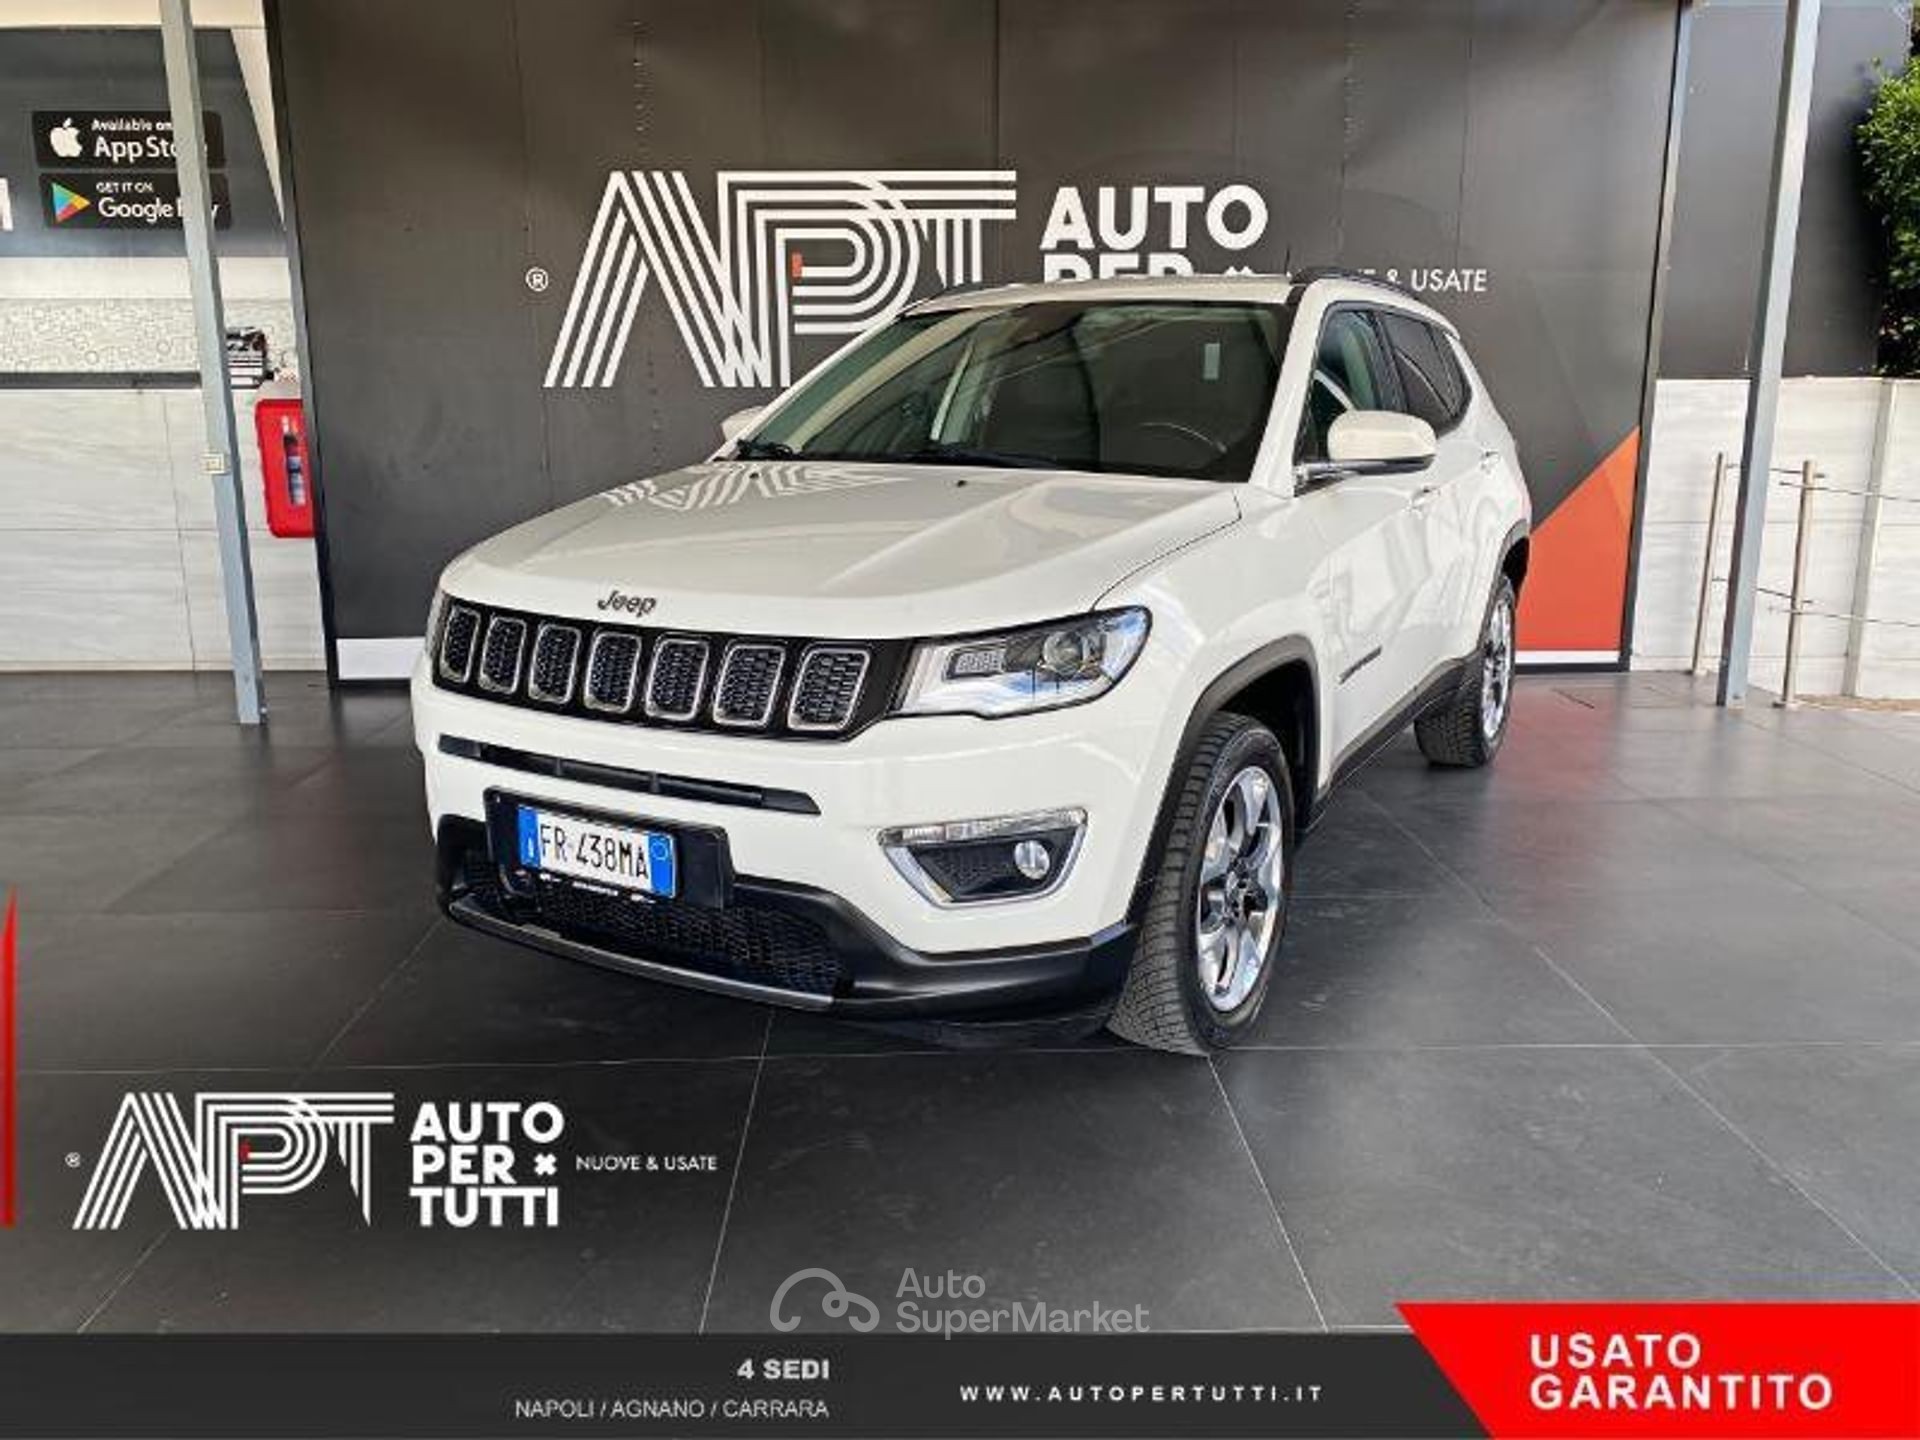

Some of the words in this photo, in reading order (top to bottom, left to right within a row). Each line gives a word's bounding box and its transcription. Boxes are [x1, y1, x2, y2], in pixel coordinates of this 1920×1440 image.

[94, 135, 143, 164] App
[95, 182, 119, 193] GET
[122, 182, 132, 193] IT
[134, 182, 154, 193] ON
[98, 196, 174, 224] Google
[1040, 184, 1268, 250] AUTO
[1410, 268, 1487, 292] USATE
[597, 590, 657, 618] Jeep
[540, 823, 567, 862] FR
[576, 833, 649, 879] 438MA
